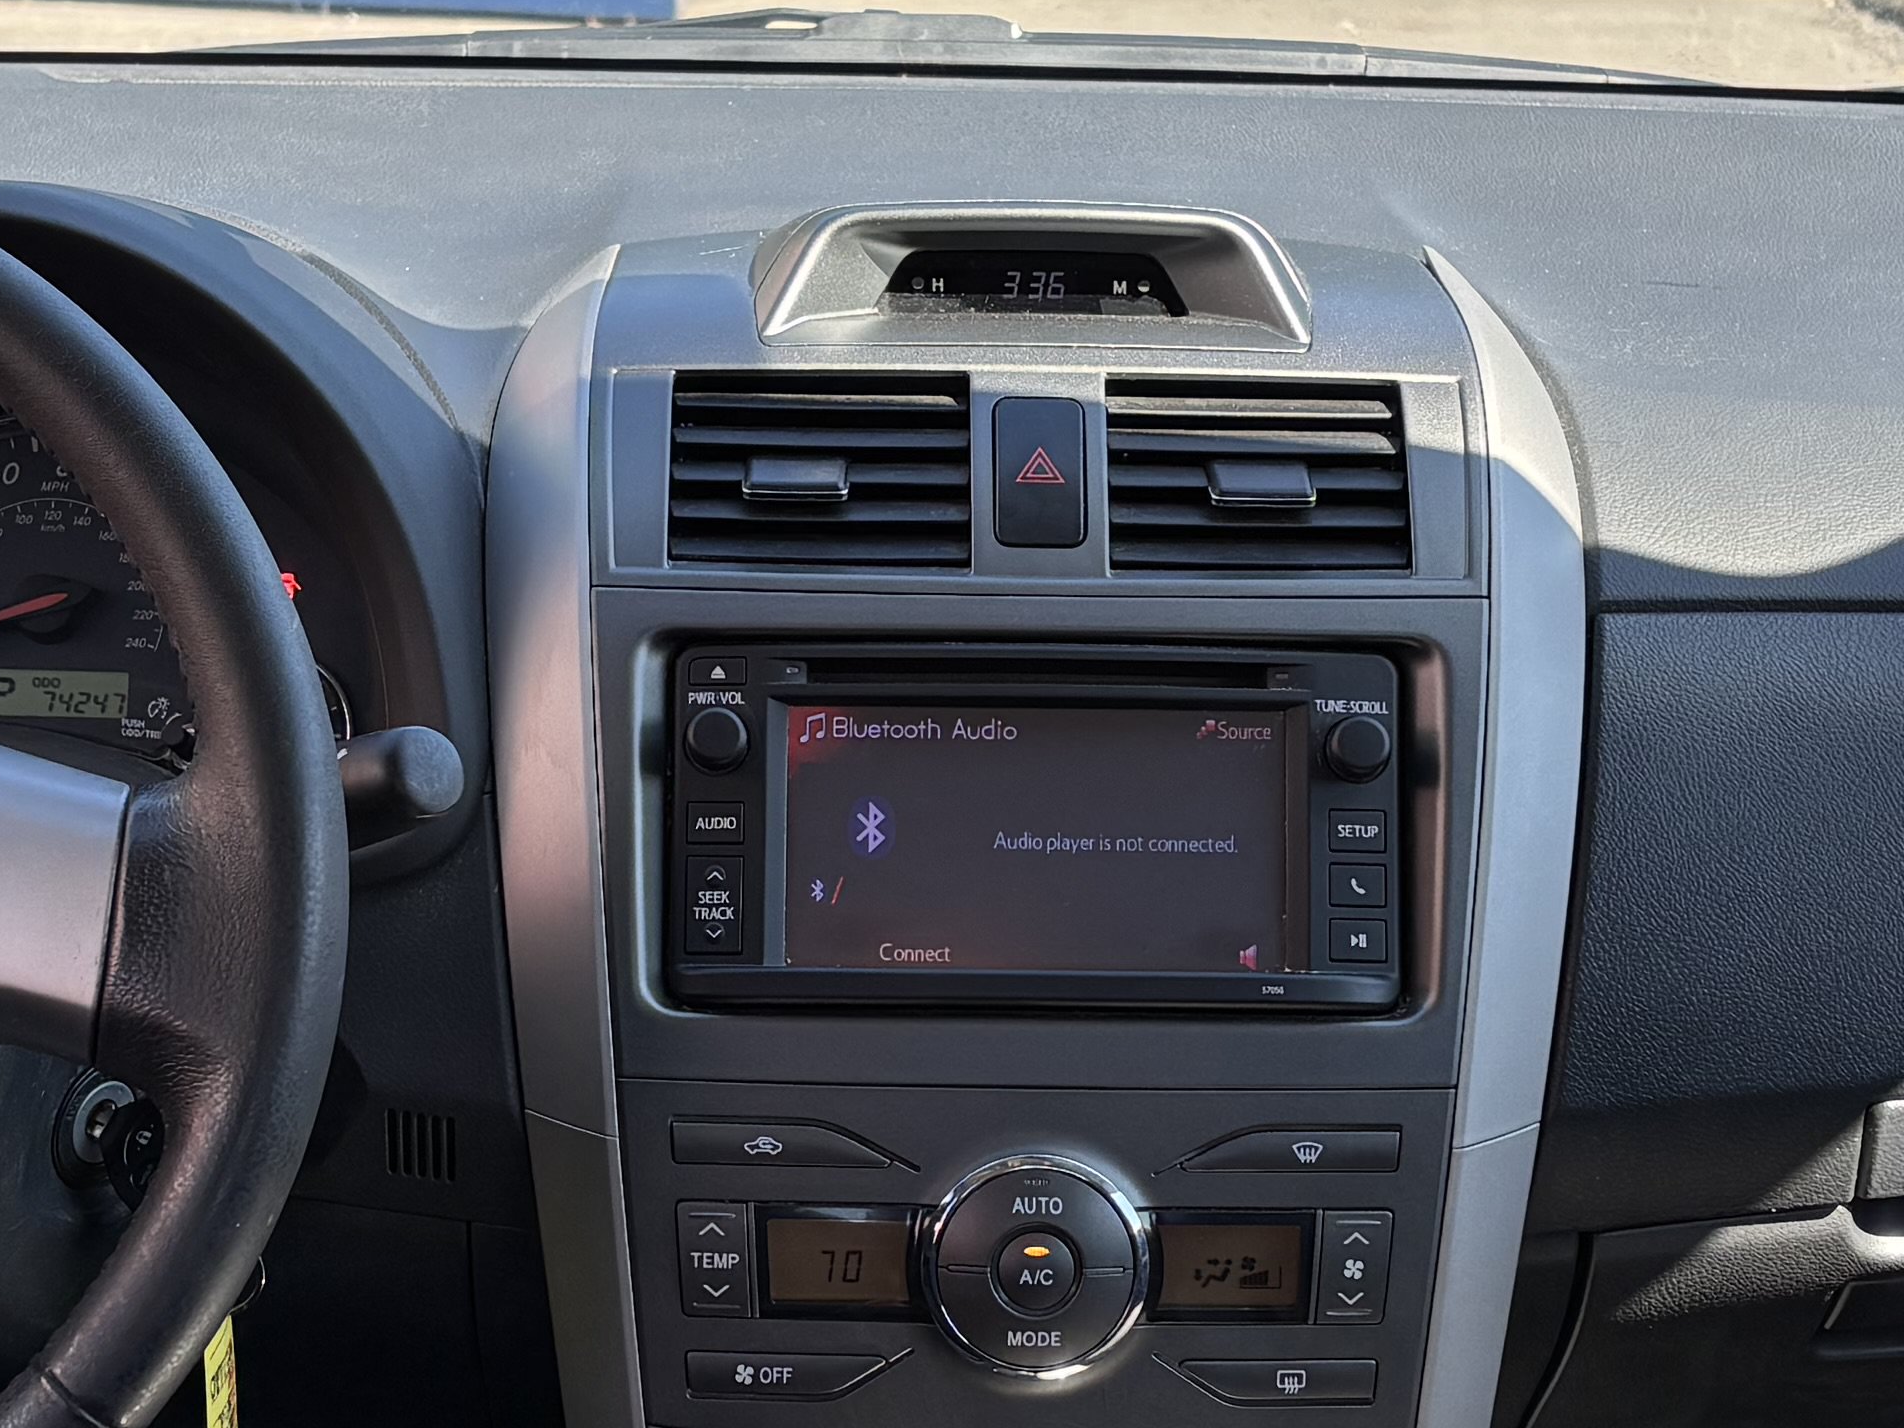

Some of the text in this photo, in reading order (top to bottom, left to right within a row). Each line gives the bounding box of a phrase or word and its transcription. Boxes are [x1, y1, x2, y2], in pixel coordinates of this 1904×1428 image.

[930, 277, 945, 292] H
[1112, 279, 1127, 295] M
[40, 481, 69, 492] MPH
[14, 514, 33, 525] 100
[43, 510, 62, 521] 120
[72, 516, 92, 527] 140
[40, 523, 65, 533] km/h
[131, 609, 154, 621] 220
[124, 637, 147, 649] 240
[31, 677, 61, 689] ODO
[42, 690, 126, 715] 74247
[832, 716, 1018, 741] Bluetooth Audio
[1216, 720, 1272, 741] Source
[695, 816, 737, 831] AUDIO
[1337, 823, 1379, 839] SETUP
[993, 831, 1239, 855] Audio player is not connected.
[697, 890, 730, 904] SEEK
[693, 906, 735, 920] TRACK
[878, 942, 952, 963] Connect
[1011, 1196, 1064, 1215] AUTO
[690, 1251, 740, 1270] TEMP
[820, 1249, 863, 1284] 70
[1018, 1268, 1054, 1287] A/C
[1006, 1329, 1062, 1349] MODE
[759, 1366, 793, 1386] OFF
